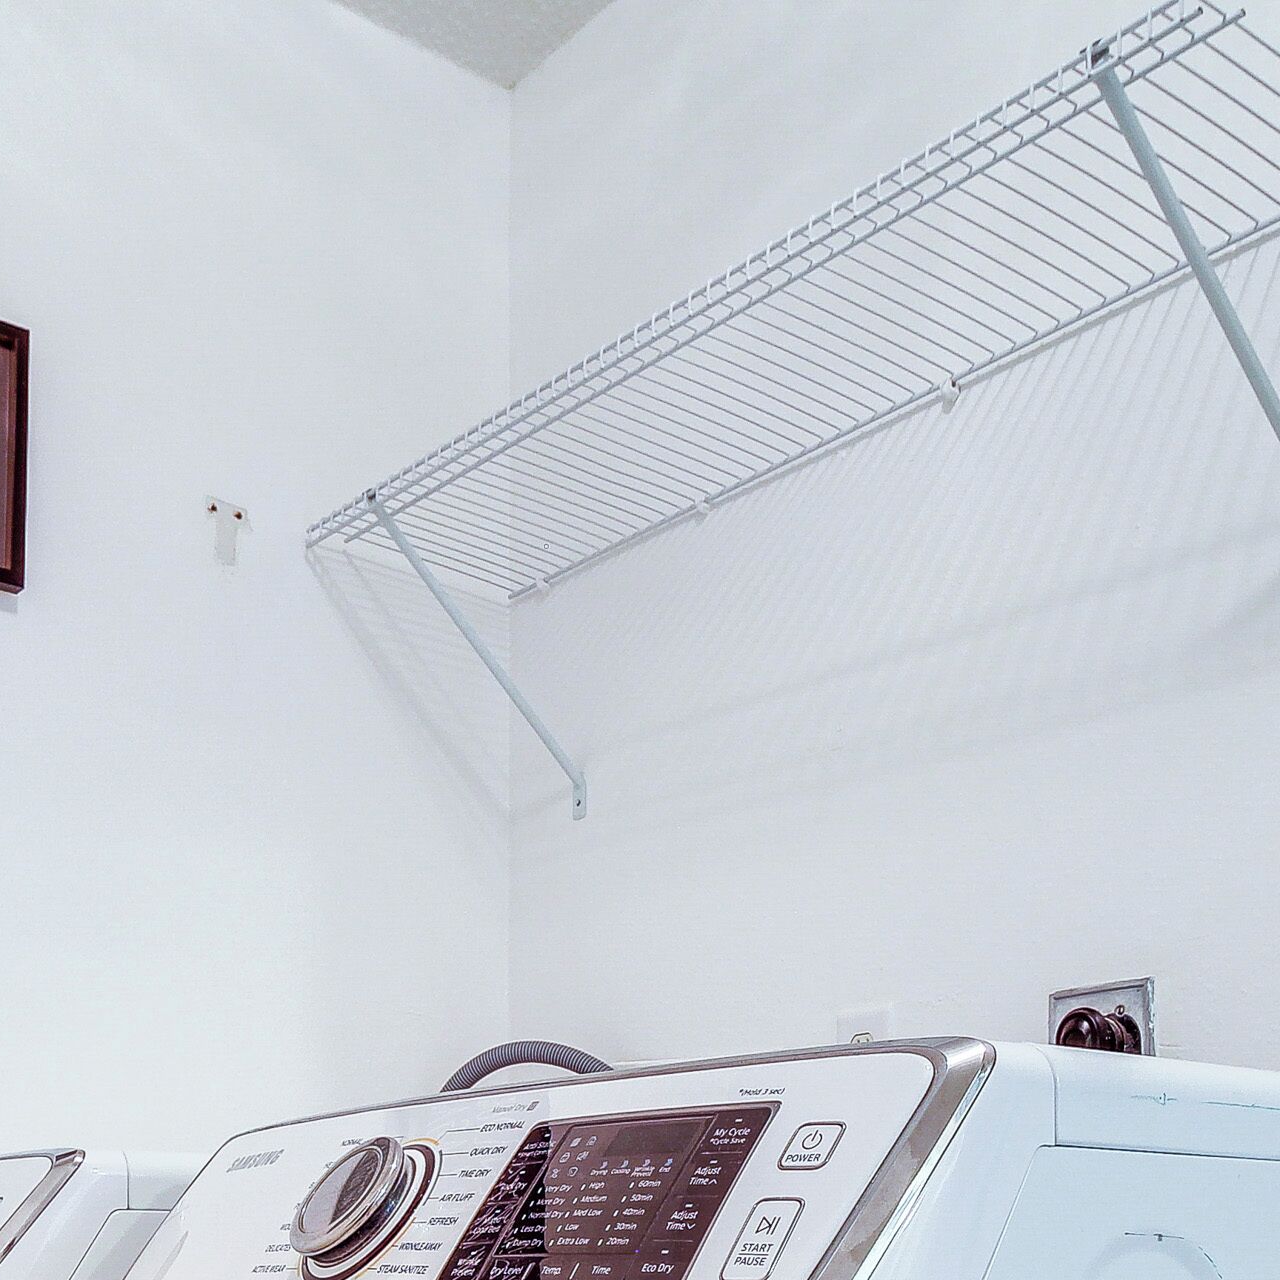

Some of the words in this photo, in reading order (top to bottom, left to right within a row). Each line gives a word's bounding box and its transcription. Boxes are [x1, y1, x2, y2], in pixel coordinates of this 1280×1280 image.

[714, 1129, 727, 1137] My
[728, 1128, 751, 1137] Cycle
[492, 1146, 508, 1155] DRY
[226, 1149, 285, 1172] SAMSUNG
[785, 1153, 821, 1163] POWER
[476, 1169, 492, 1177] DRY
[694, 1167, 721, 1176] Adjust
[638, 1180, 661, 1188] 60min
[689, 1177, 709, 1185] Time
[560, 1184, 572, 1193] Dry
[589, 1182, 605, 1190] High
[454, 1193, 475, 1202] FLUFF
[630, 1193, 653, 1201] 50min
[552, 1198, 565, 1206] Dry
[551, 1211, 564, 1220] Dry
[587, 1209, 603, 1217] Low
[622, 1208, 645, 1216] 40min
[671, 1211, 698, 1220] Adjust
[427, 1217, 458, 1225] REFRESH
[535, 1225, 547, 1234] Dry
[565, 1223, 579, 1231] Low
[614, 1223, 637, 1231] 30min
[666, 1222, 685, 1230] Time
[531, 1239, 544, 1248] Dry
[575, 1237, 590, 1245] Low
[606, 1237, 629, 1245] 20min
[741, 1243, 774, 1253] START
[734, 1257, 766, 1267] PAUSE
[591, 1265, 611, 1274] Time
[641, 1264, 657, 1273] Eco
[657, 1264, 674, 1275] Dry
